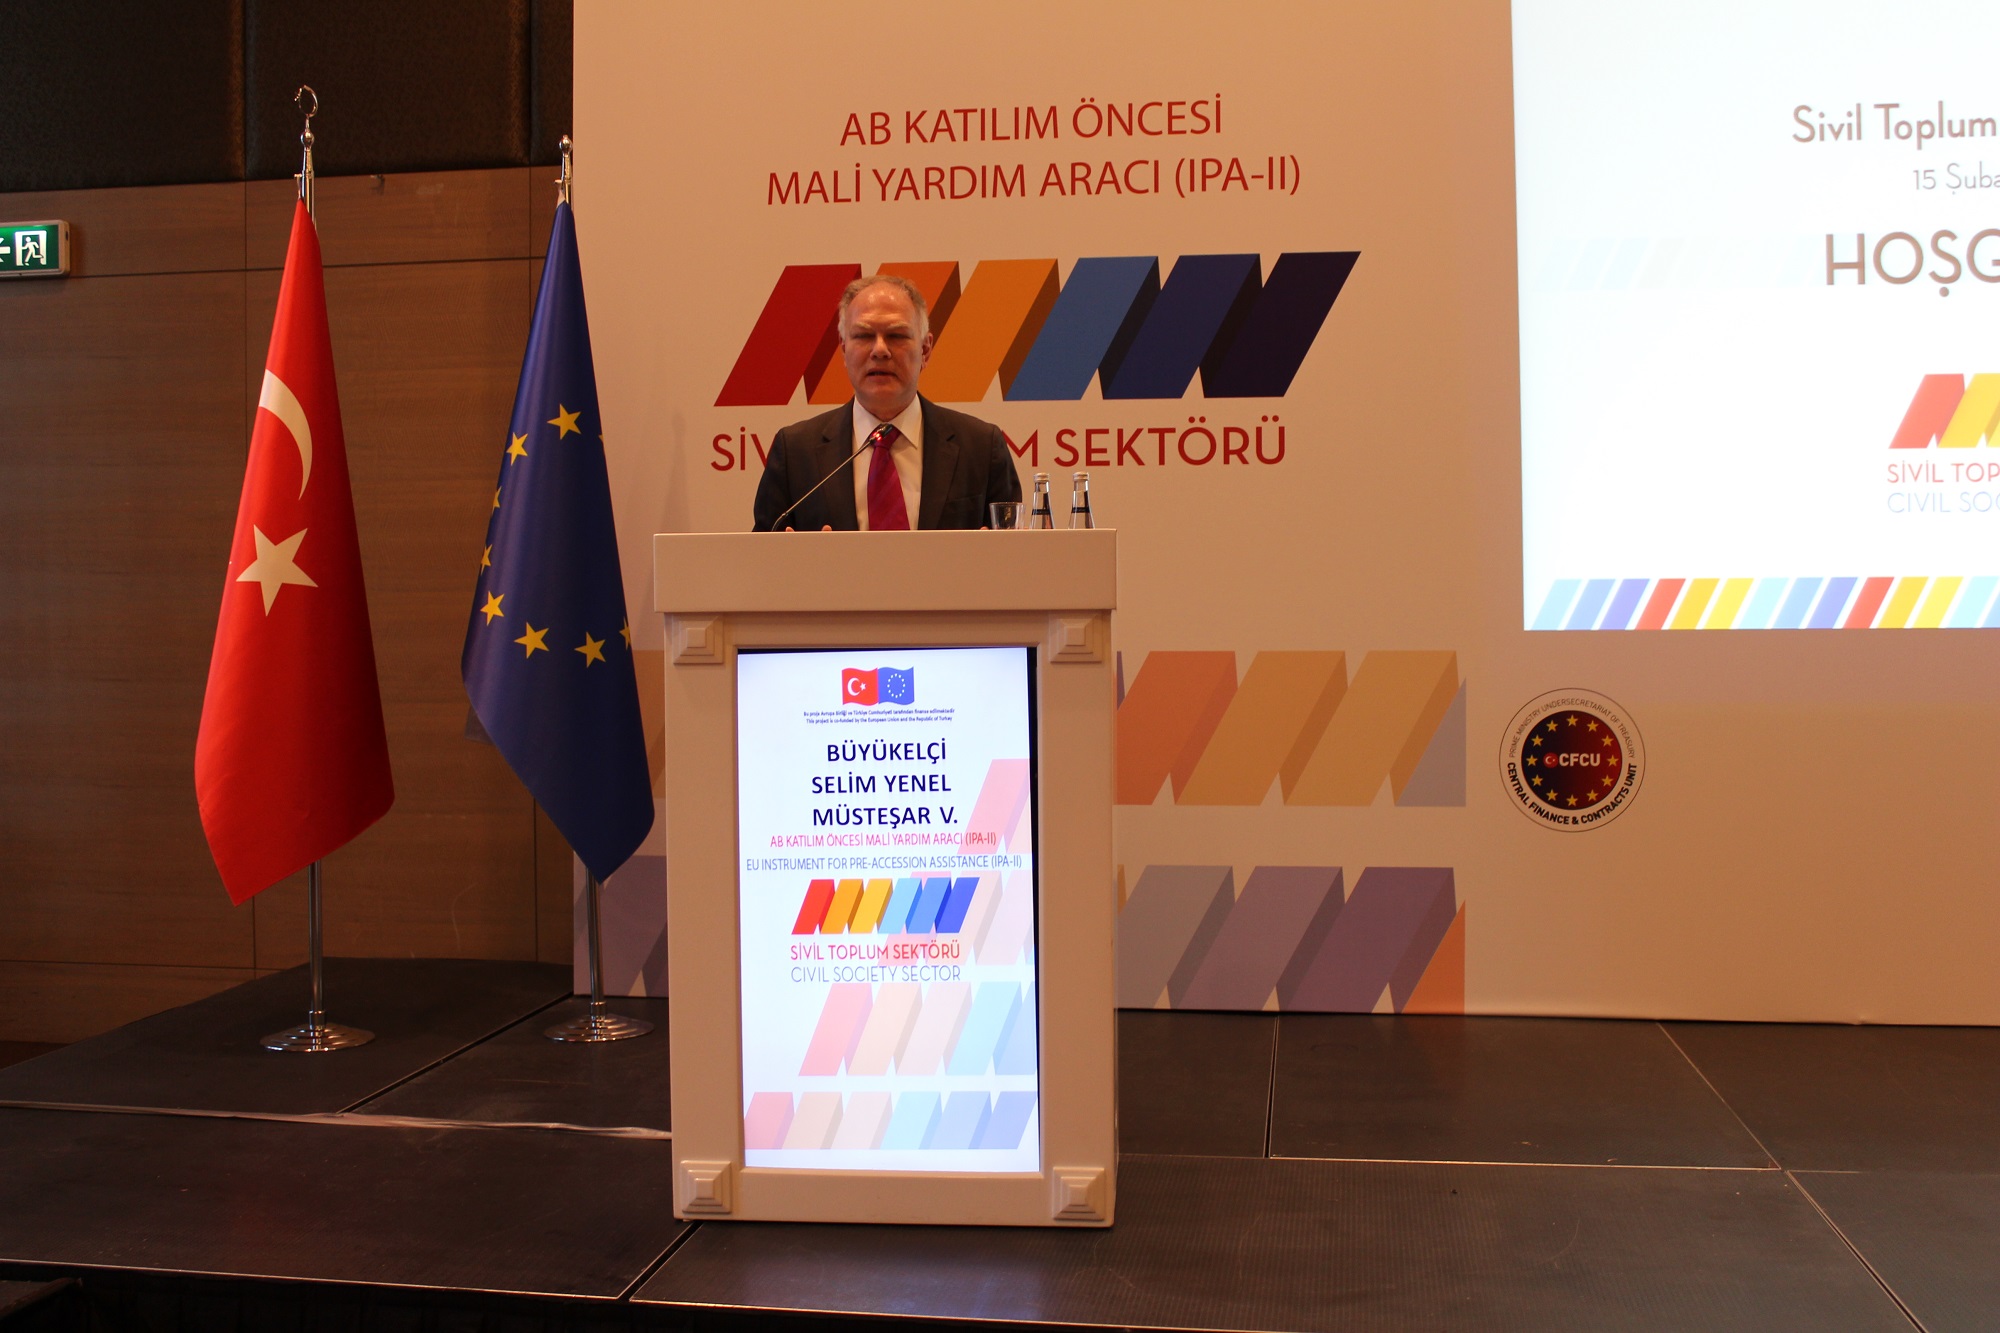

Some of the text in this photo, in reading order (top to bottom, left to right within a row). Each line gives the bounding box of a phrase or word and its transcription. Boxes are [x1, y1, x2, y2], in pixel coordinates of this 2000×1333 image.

[840, 93, 1221, 146] AB KATILIM ÖNCESİ
[1792, 100, 1997, 151] Sivil Toplum
[768, 154, 1300, 205] MALİ YARDIM ARACI (IPA-II)
[1912, 169, 1937, 190] 15
[1825, 228, 2000, 298] HOŞG
[710, 426, 778, 472] SİV
[1053, 415, 1286, 470] SEKTÖRÜ
[1887, 459, 2000, 484] SİVİL TOP
[1887, 490, 2000, 513] CIVIL SO
[1509, 698, 1636, 759] PRIME MINISTRY UNDERSECRETARIAT OF TREASURY
[827, 737, 946, 765] BÜYÜKELÇİ
[1558, 752, 1601, 767] CFCU
[811, 771, 952, 794] SELİM YENEL
[1507, 762, 1638, 825] CENTRAL FINANCE & CONTRACTS UNIT
[813, 803, 958, 829] MÜSTEŞAR V.
[770, 831, 997, 848] AB KATILIM ÖNCESİ MALİ YARDIM ARACI (IPA-II)
[746, 854, 1022, 871] EU INSTRUMENT FOR PRE-ACCESSION ASSISTANCE (IPA-II)
[790, 939, 961, 961] SİVİL TOPLUM SEKTÖRÜ
[791, 965, 961, 983] CIVIL SOCIETY SECTOR
